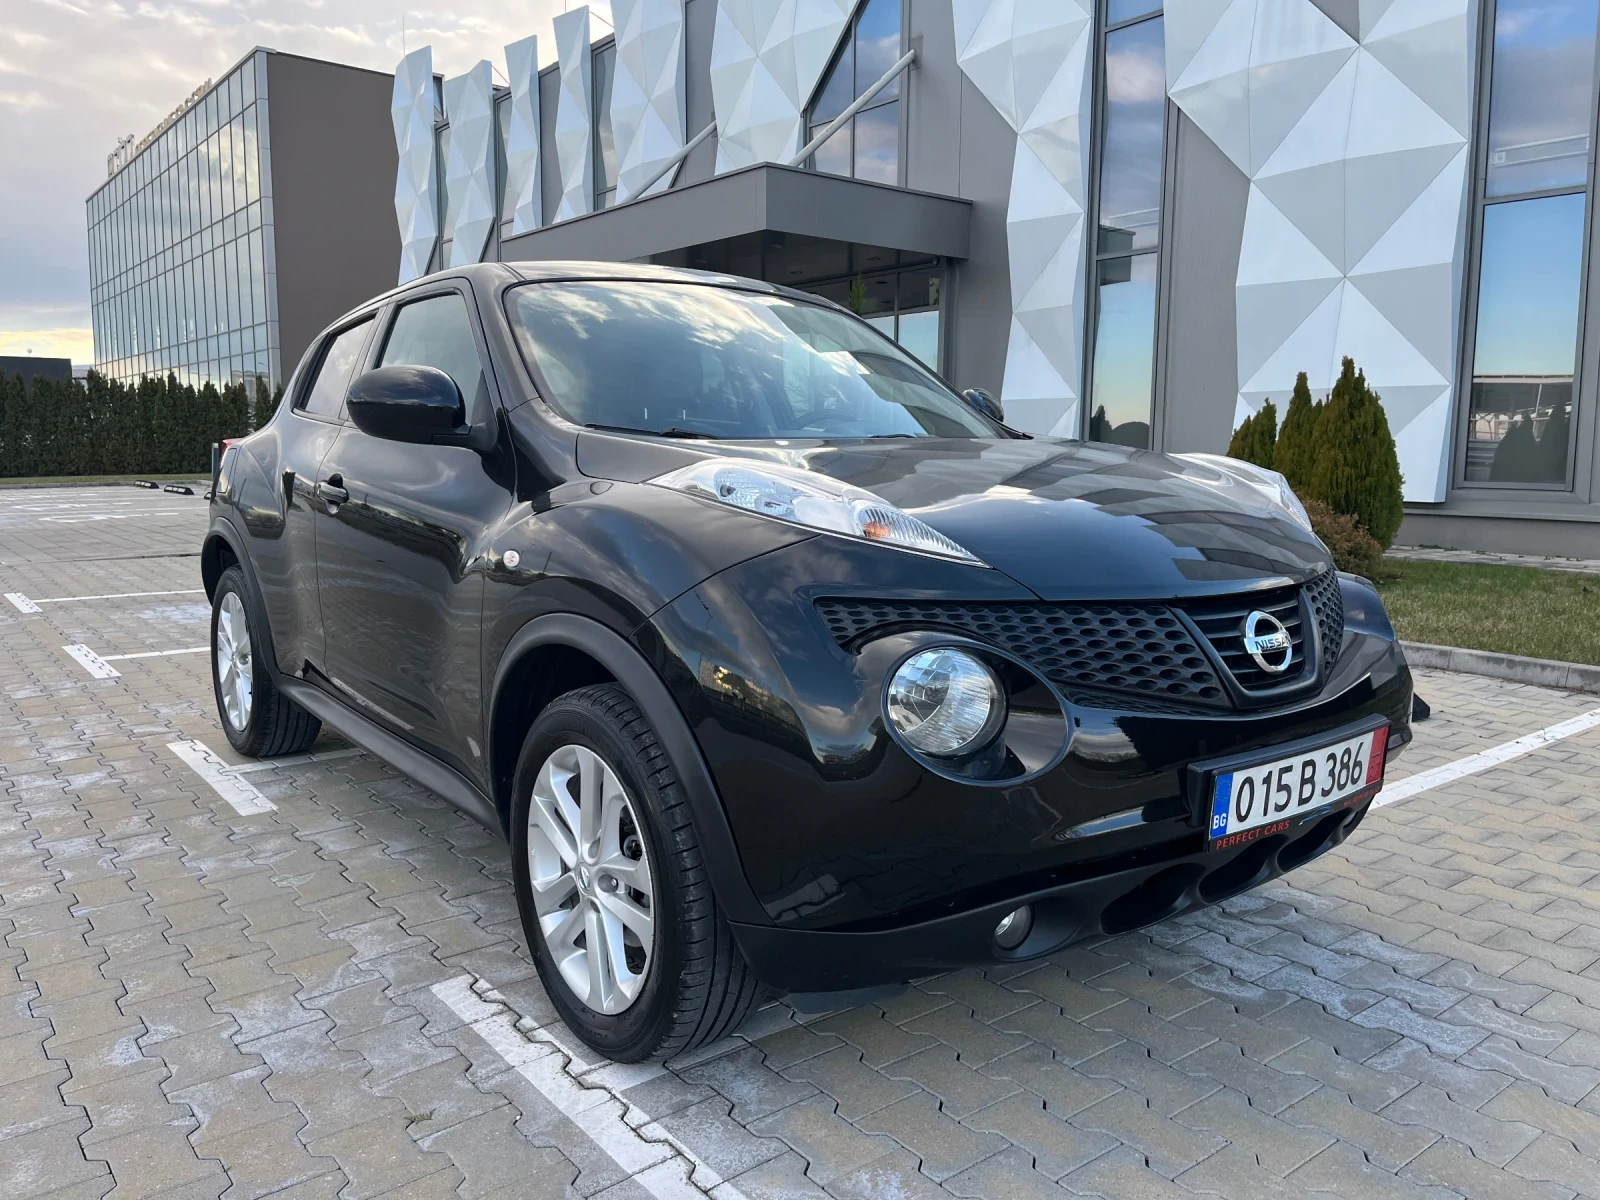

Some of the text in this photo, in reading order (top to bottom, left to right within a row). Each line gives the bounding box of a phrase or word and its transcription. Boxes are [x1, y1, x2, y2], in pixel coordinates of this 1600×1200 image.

[1212, 812, 1227, 830] BG
[1216, 820, 1290, 850] PERFECT CARS
